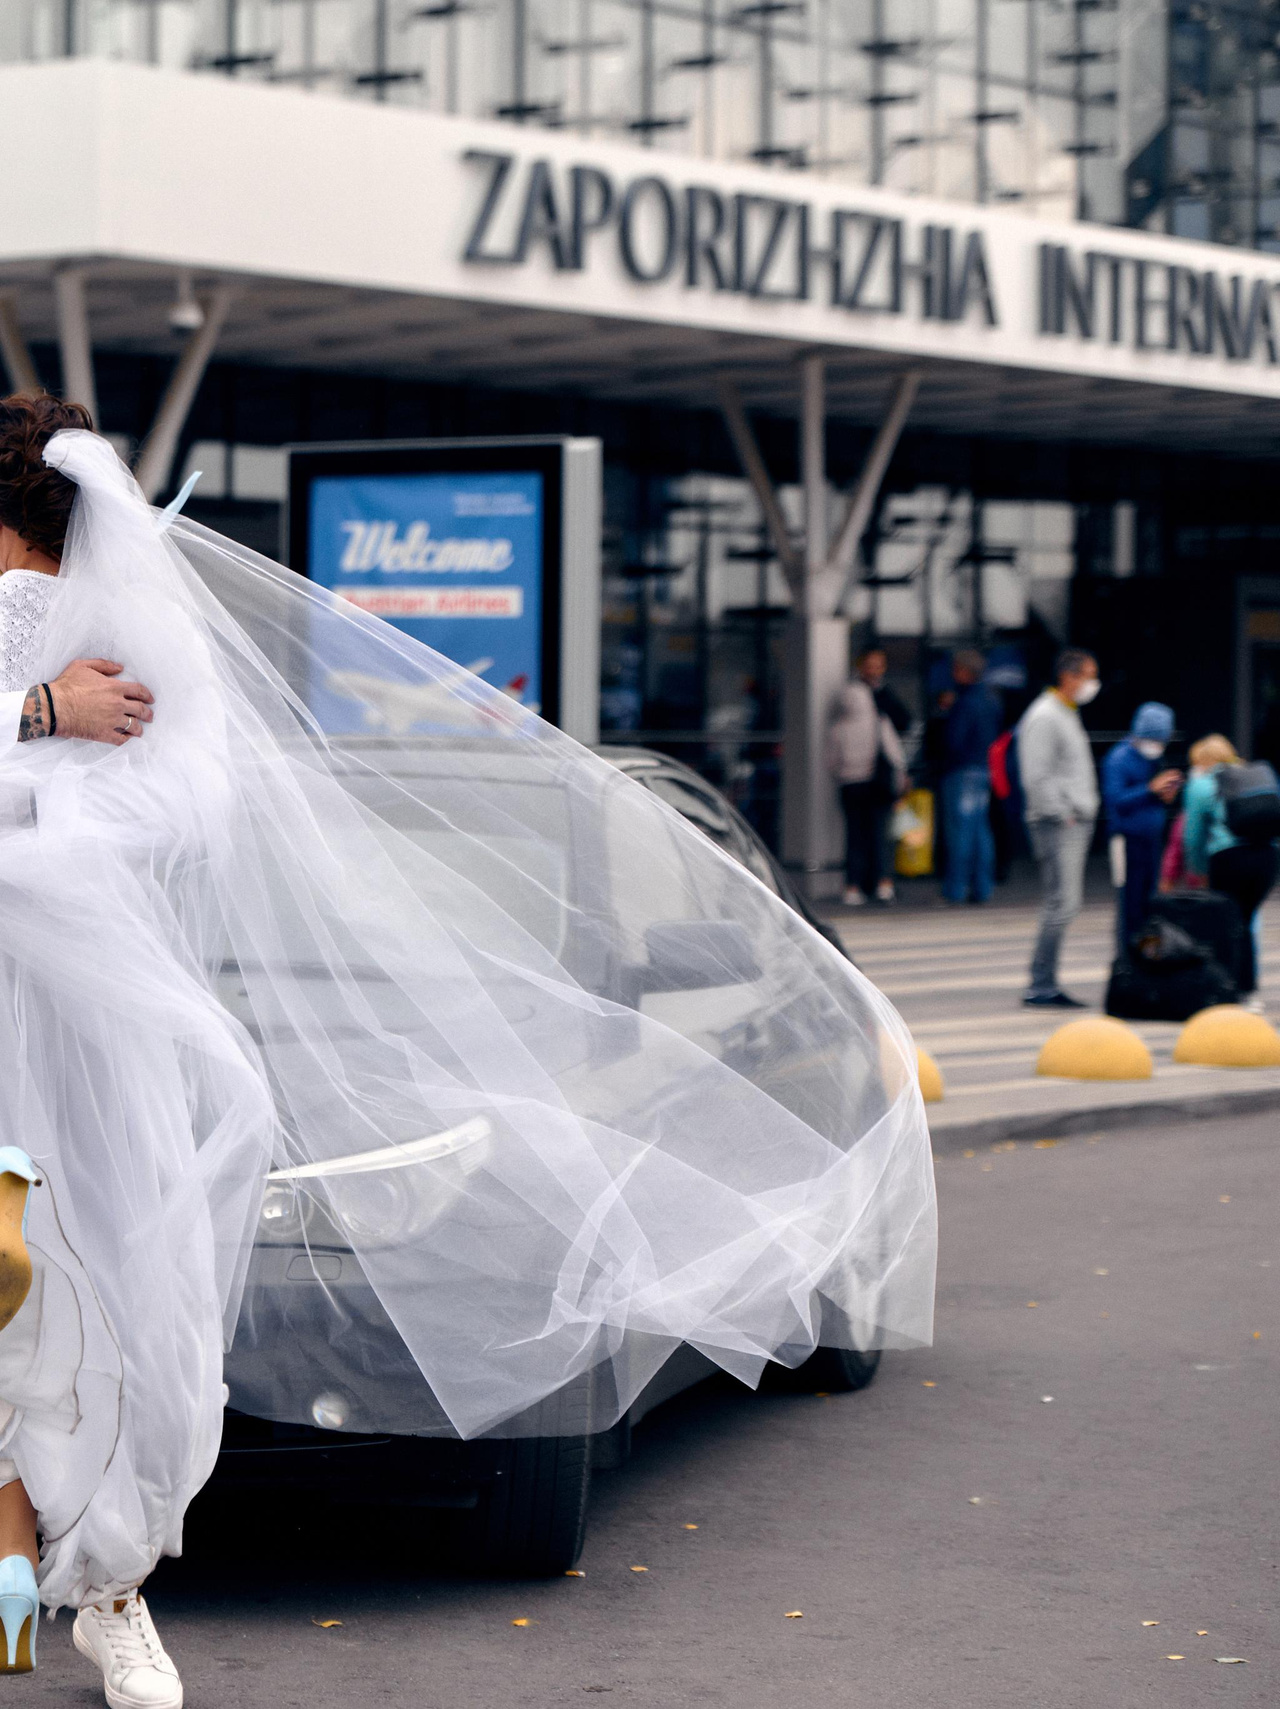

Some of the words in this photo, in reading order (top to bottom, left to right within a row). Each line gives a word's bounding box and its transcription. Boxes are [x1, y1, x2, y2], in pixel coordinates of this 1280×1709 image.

[463, 149, 997, 327] ZAPORIZHZHIA
[1039, 243, 1280, 364] INTERNA
[340, 520, 515, 573] Welcome
